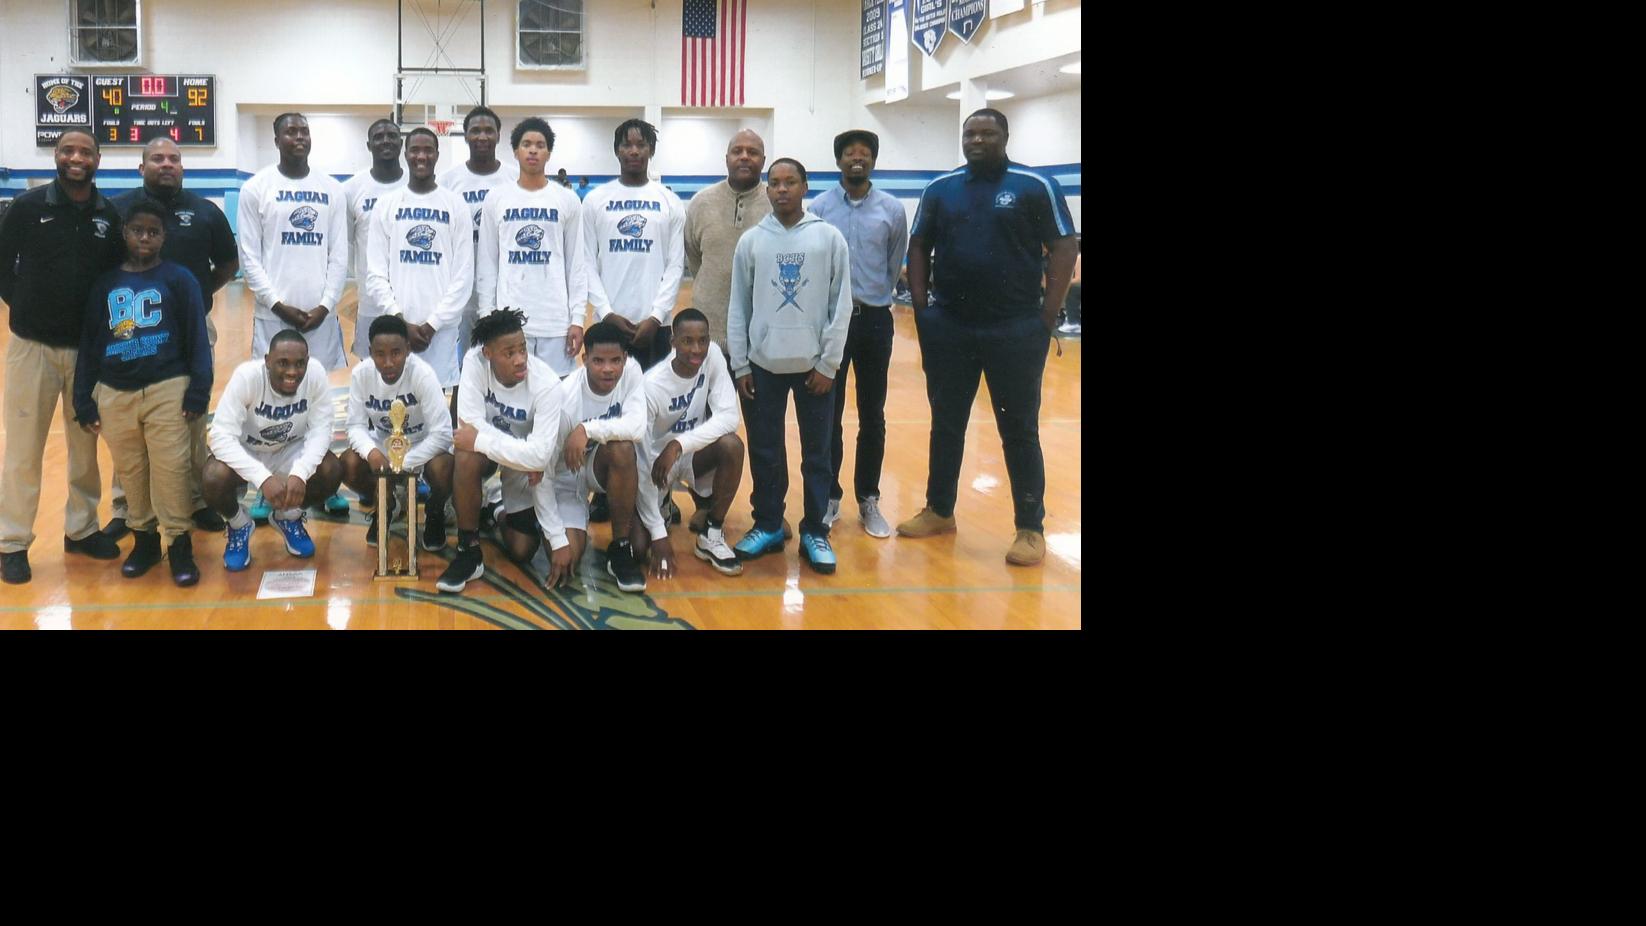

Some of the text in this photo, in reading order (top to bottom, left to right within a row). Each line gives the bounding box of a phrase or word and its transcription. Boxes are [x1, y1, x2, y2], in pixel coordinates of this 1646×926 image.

[866, 6, 880, 22] 2009
[41, 77, 60, 89] HOME
[95, 78, 124, 86] GUEST
[183, 78, 209, 86] HOME
[102, 88, 122, 106] 40
[188, 88, 208, 106] 92
[131, 103, 157, 111] PERIOD
[160, 100, 169, 113] 4
[40, 113, 87, 123] JAGUARS
[109, 127, 117, 141] 3
[129, 127, 139, 141] 3
[169, 127, 178, 141] 4
[195, 127, 203, 141] 7
[276, 189, 329, 206] JAGUAR
[605, 199, 661, 213] JAGUAR
[395, 207, 450, 225] JAGUAR
[503, 207, 559, 223] JAGUAR
[281, 231, 324, 246] FAMILY
[609, 239, 654, 253] FAMILY
[399, 249, 443, 266] FAMILY
[508, 250, 552, 265] FAMILY
[108, 287, 162, 329] BC
[254, 399, 308, 421] JAGUAR
